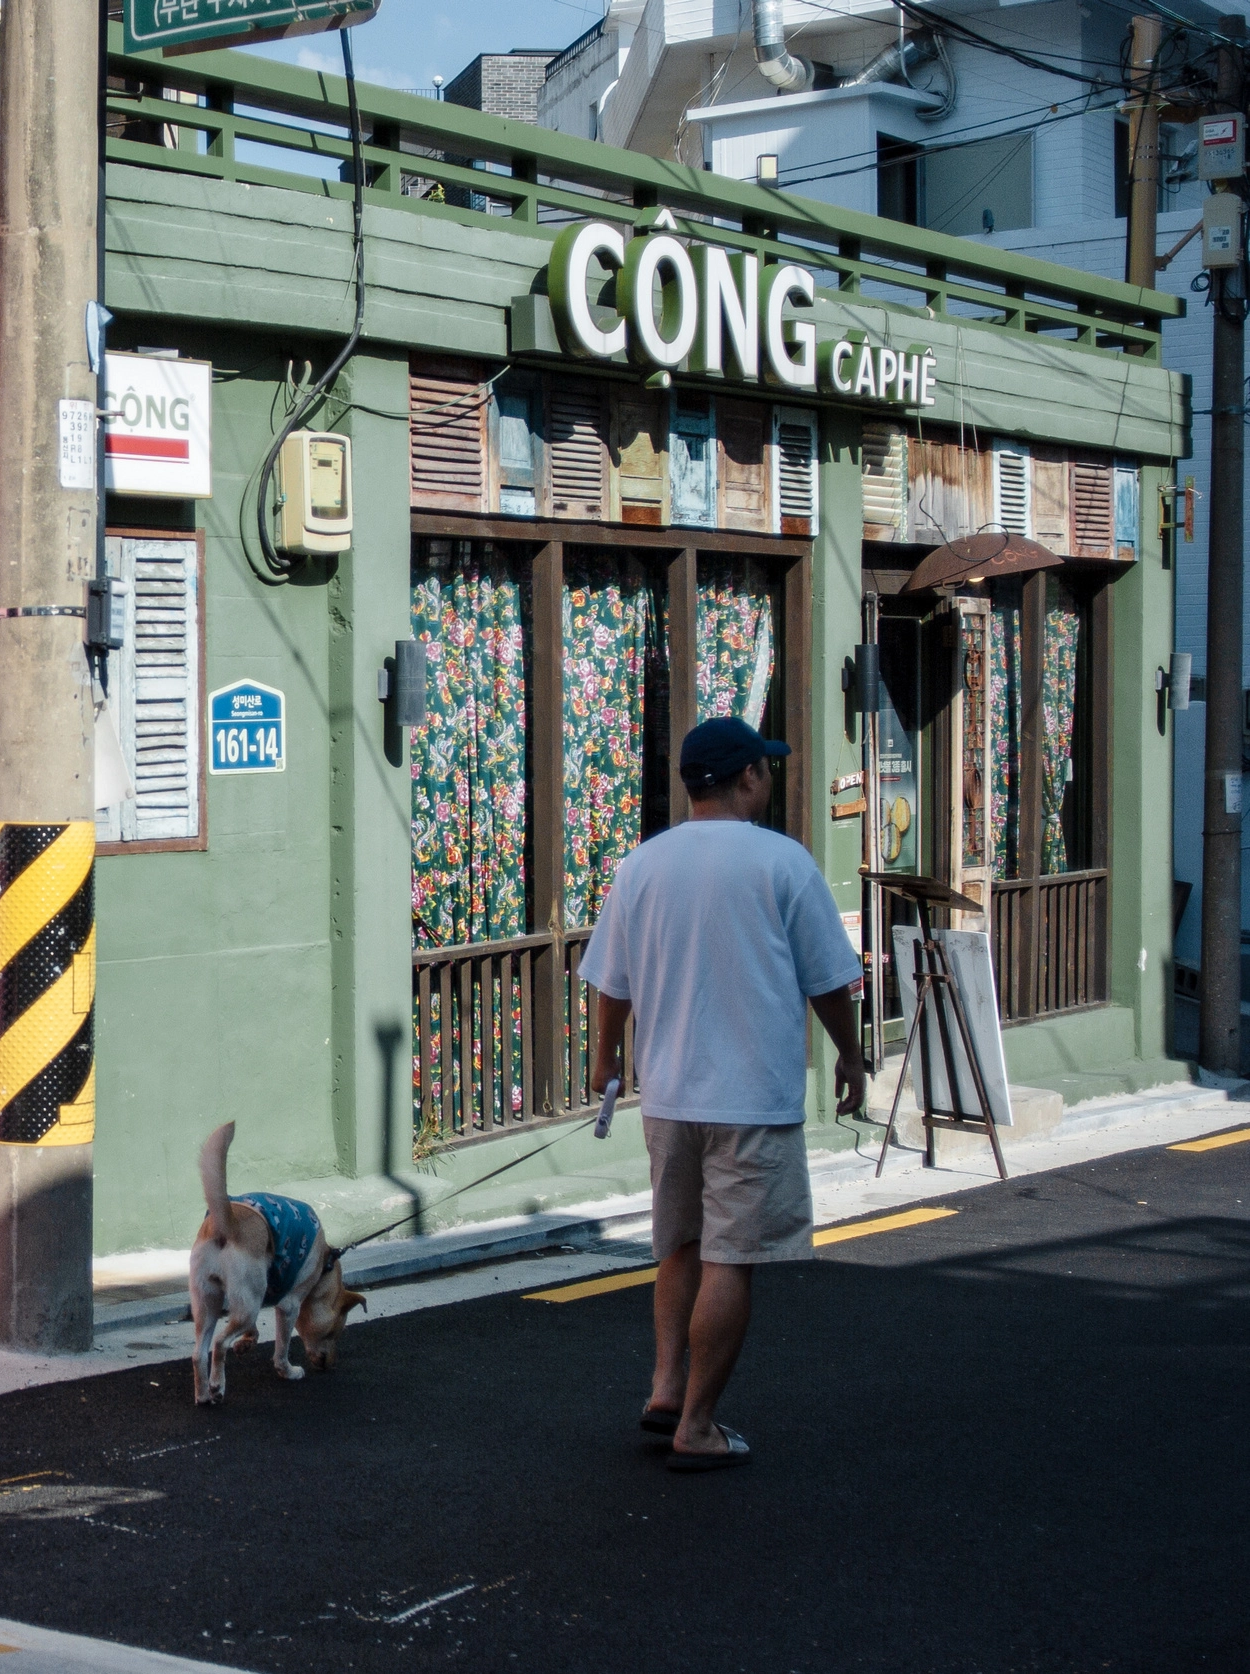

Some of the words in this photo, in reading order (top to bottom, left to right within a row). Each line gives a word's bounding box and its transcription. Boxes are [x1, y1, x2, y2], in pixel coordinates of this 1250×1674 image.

[232, 695, 263, 709] 성미산로
[216, 728, 279, 763] 161-14
[839, 774, 862, 789] OPEN
